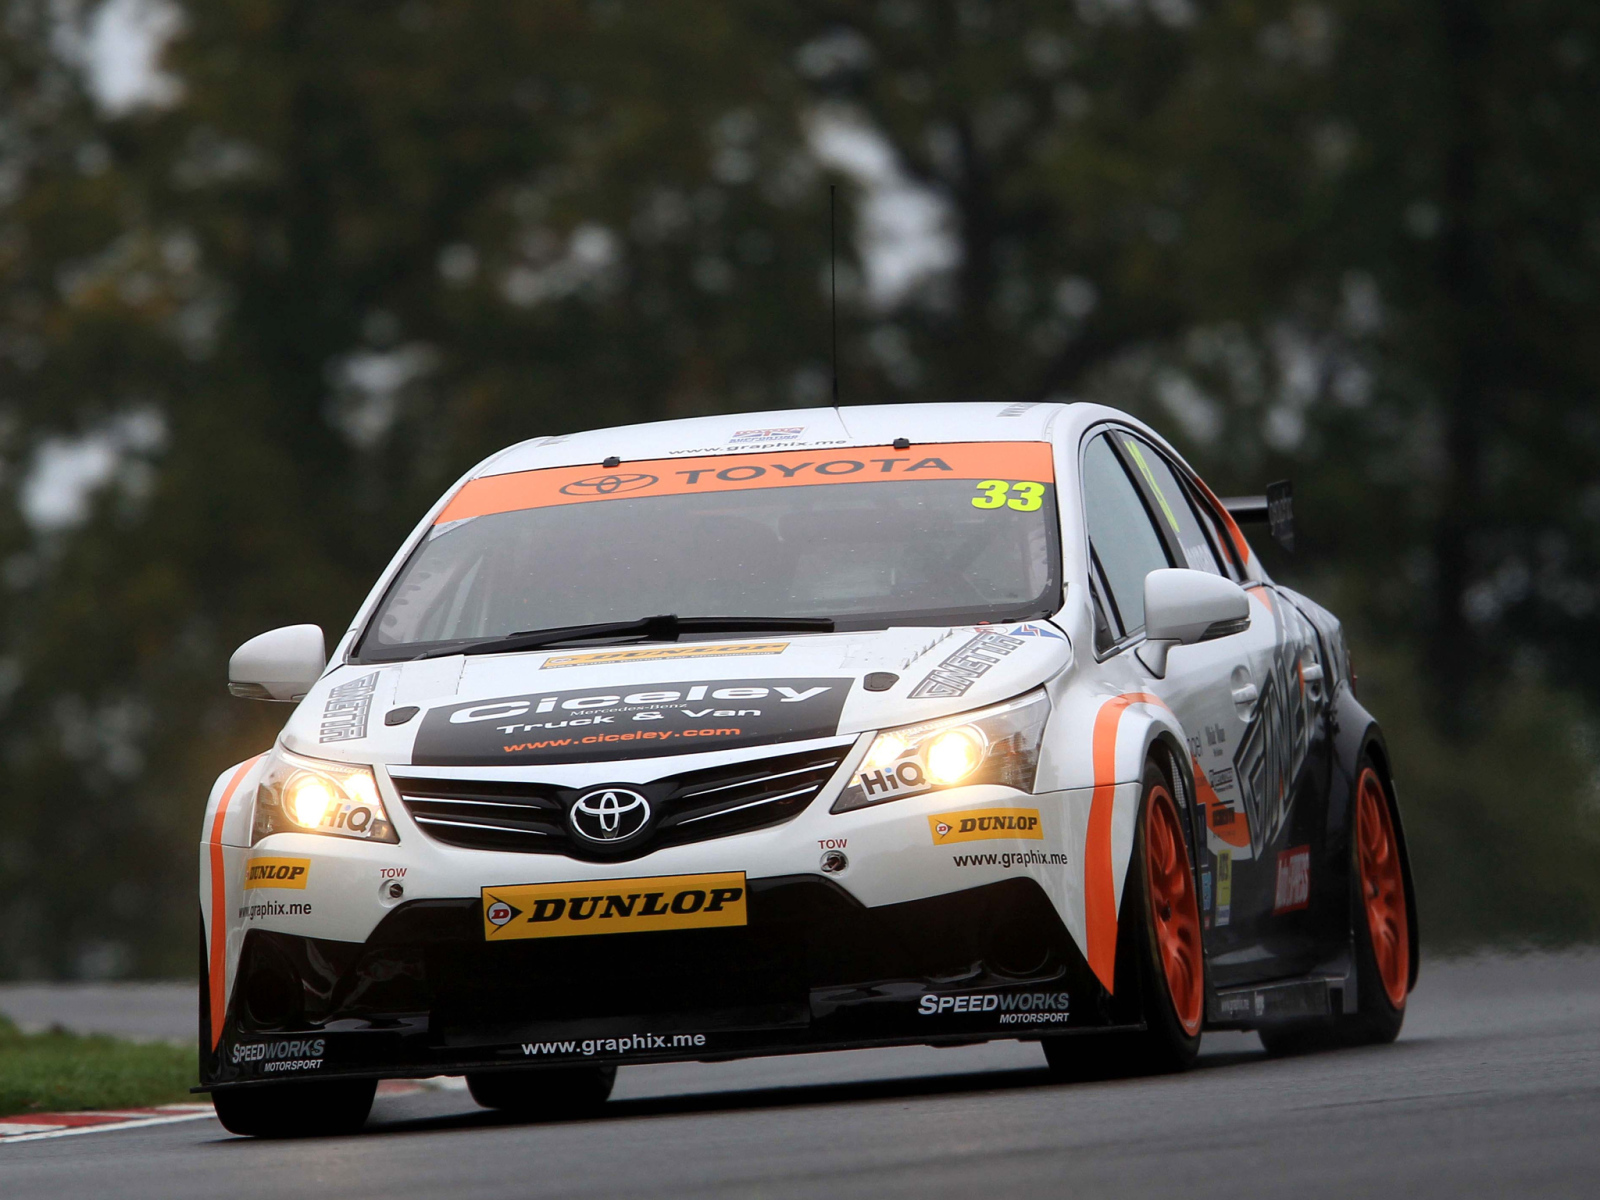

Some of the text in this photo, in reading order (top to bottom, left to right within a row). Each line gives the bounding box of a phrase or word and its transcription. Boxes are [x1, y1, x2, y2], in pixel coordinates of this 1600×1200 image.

[669, 439, 847, 455] www.graphix.me
[675, 457, 954, 485] TOYOTA
[971, 479, 1046, 512] 33
[587, 643, 787, 660] DUNLOP
[907, 630, 1026, 699] GINETTA
[449, 684, 833, 725] Ciceley
[569, 702, 688, 717] Mercedes-Benz
[496, 708, 762, 735] Truck & Van
[503, 726, 741, 753] www.ciceley.com
[860, 761, 927, 795] HiQ
[320, 802, 372, 833] HiQ
[958, 815, 1038, 834] DUNLOP
[818, 838, 848, 850] TOW
[953, 850, 1068, 868] www.graphix.me
[248, 864, 305, 880] DUNLOP
[380, 868, 408, 879] TOW
[527, 887, 744, 923] DUNLOP
[999, 1012, 1070, 1024] MOTORSPORT
[521, 1033, 706, 1056] www.graphix.me
[264, 1059, 323, 1072] MOTORSPORT
